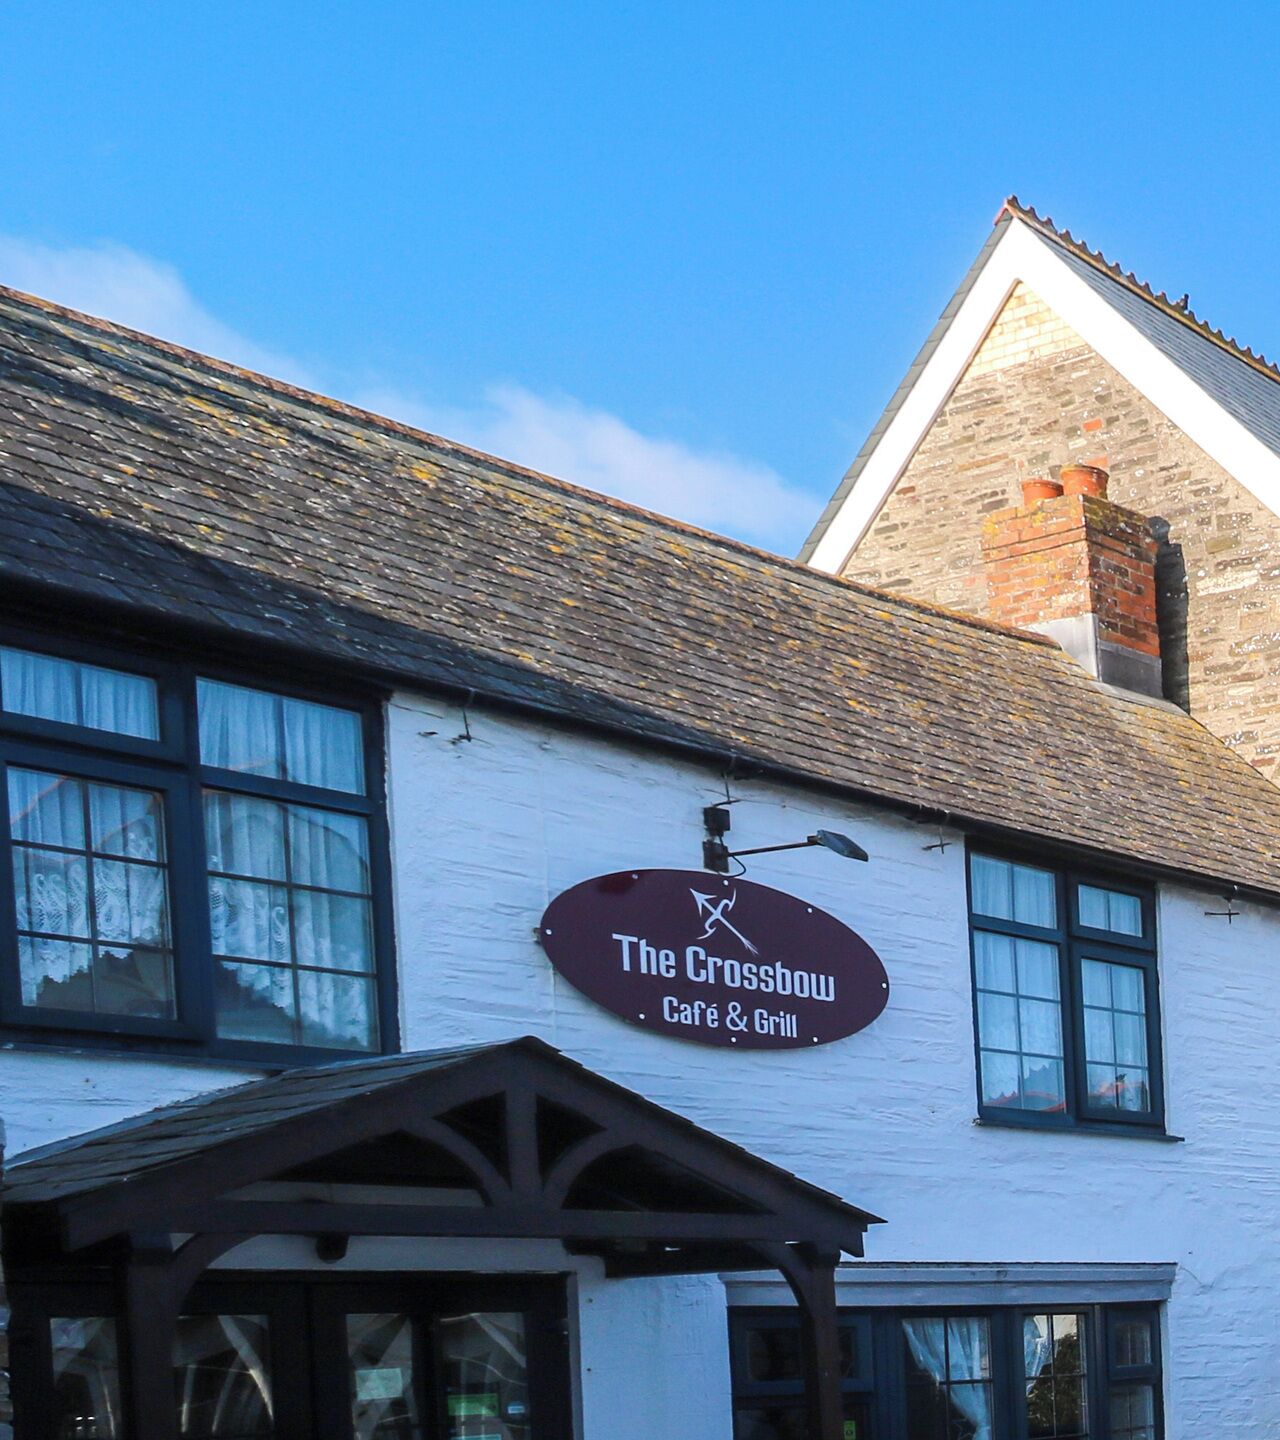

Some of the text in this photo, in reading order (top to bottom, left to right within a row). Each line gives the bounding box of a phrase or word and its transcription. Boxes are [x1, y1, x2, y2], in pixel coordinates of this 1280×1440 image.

[612, 933, 836, 1002] The Crossbow
[662, 996, 798, 1038] Café & Grill
